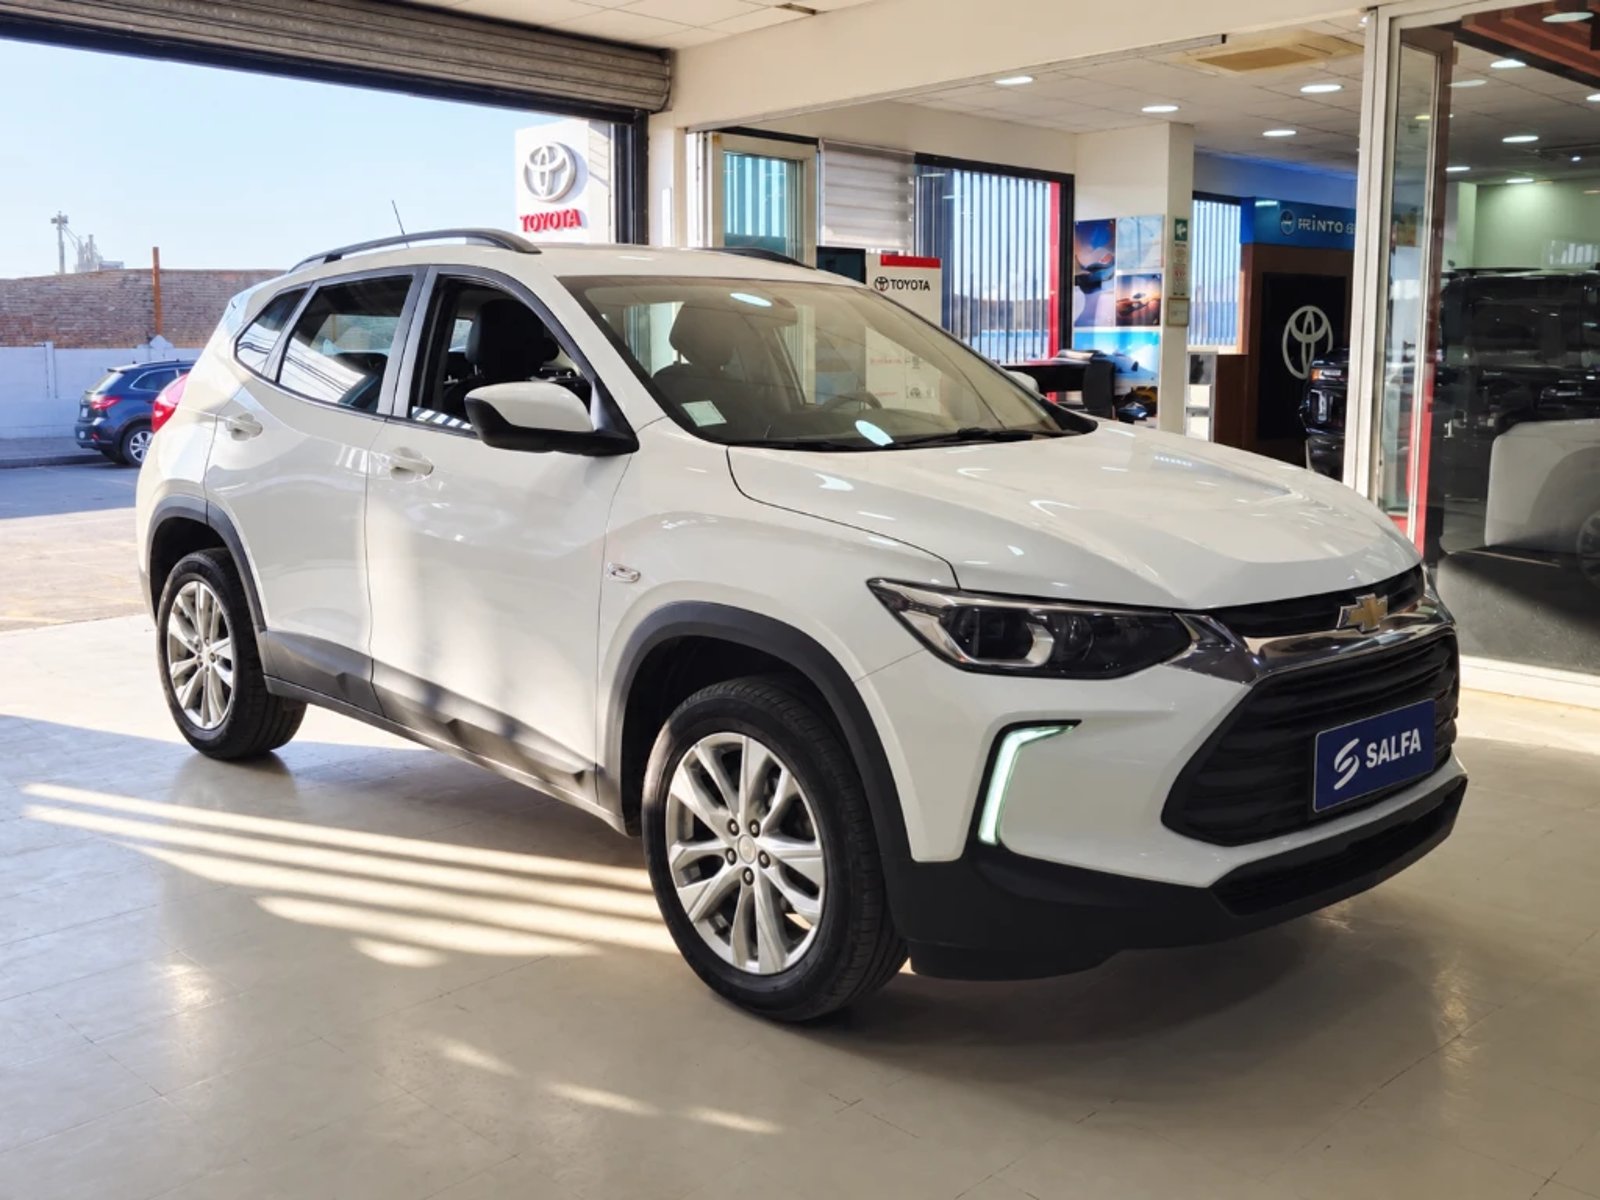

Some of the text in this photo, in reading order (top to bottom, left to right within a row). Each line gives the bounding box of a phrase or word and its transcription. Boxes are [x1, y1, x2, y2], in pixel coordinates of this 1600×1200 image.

[520, 208, 582, 232] TOYOTA
[890, 279, 931, 292] TOYOTA
[1365, 728, 1422, 768] SALFA
